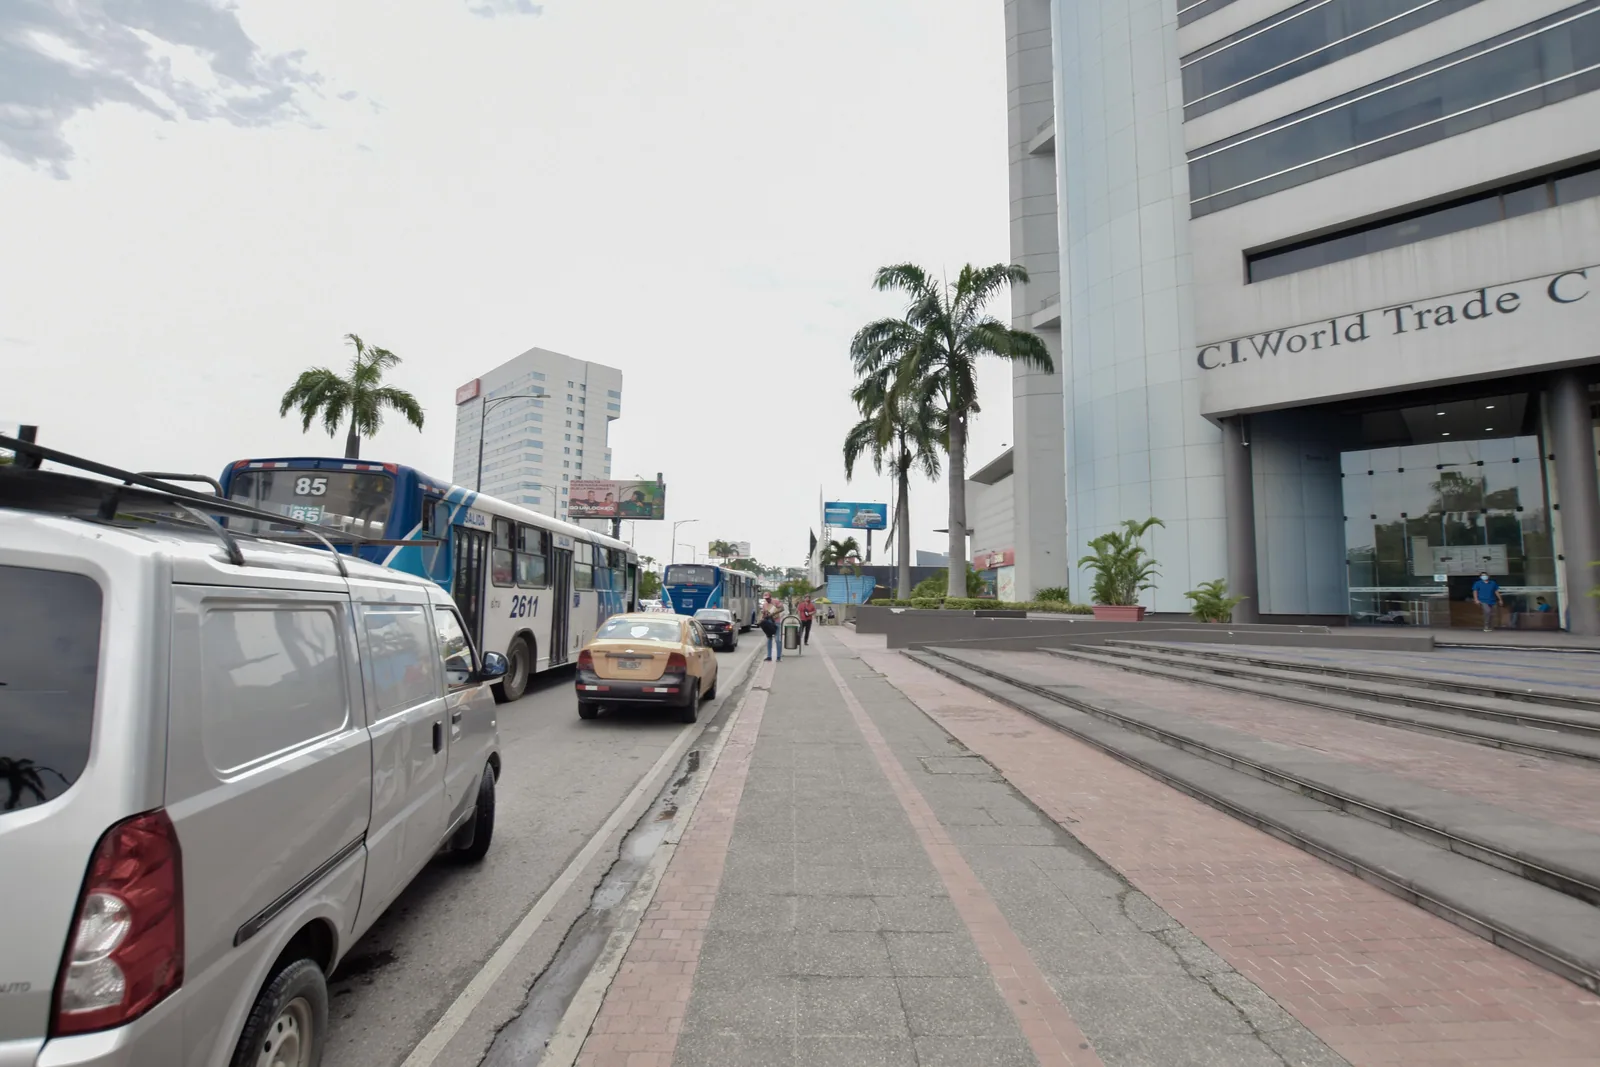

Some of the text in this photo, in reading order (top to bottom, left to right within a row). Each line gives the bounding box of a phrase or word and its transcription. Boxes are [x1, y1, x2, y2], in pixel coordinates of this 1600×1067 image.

[1383, 287, 1521, 335] Trade
[1547, 269, 1590, 304] C
[295, 477, 327, 496] 85
[291, 510, 319, 522] 85
[464, 511, 485, 527] SALIDA
[509, 595, 539, 618] 2611
